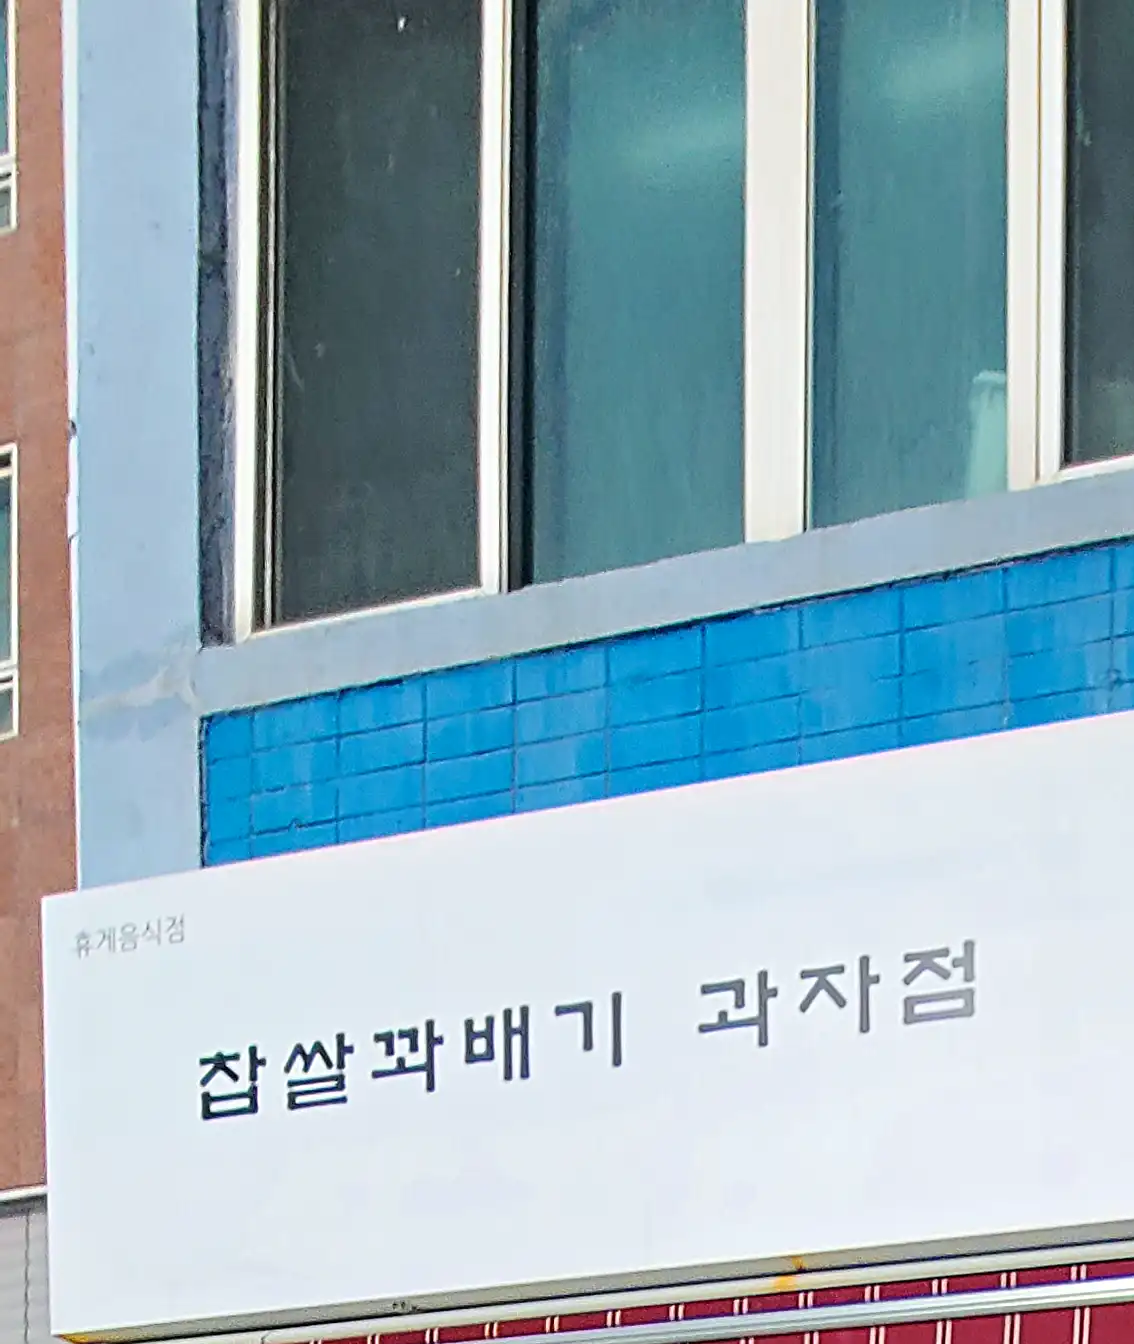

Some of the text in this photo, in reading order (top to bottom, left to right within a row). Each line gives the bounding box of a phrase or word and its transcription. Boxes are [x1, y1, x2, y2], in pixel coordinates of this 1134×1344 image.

[72, 913, 185, 960] 휴게음식점
[199, 939, 979, 1121] 찹쌀꽈배기 과자점
